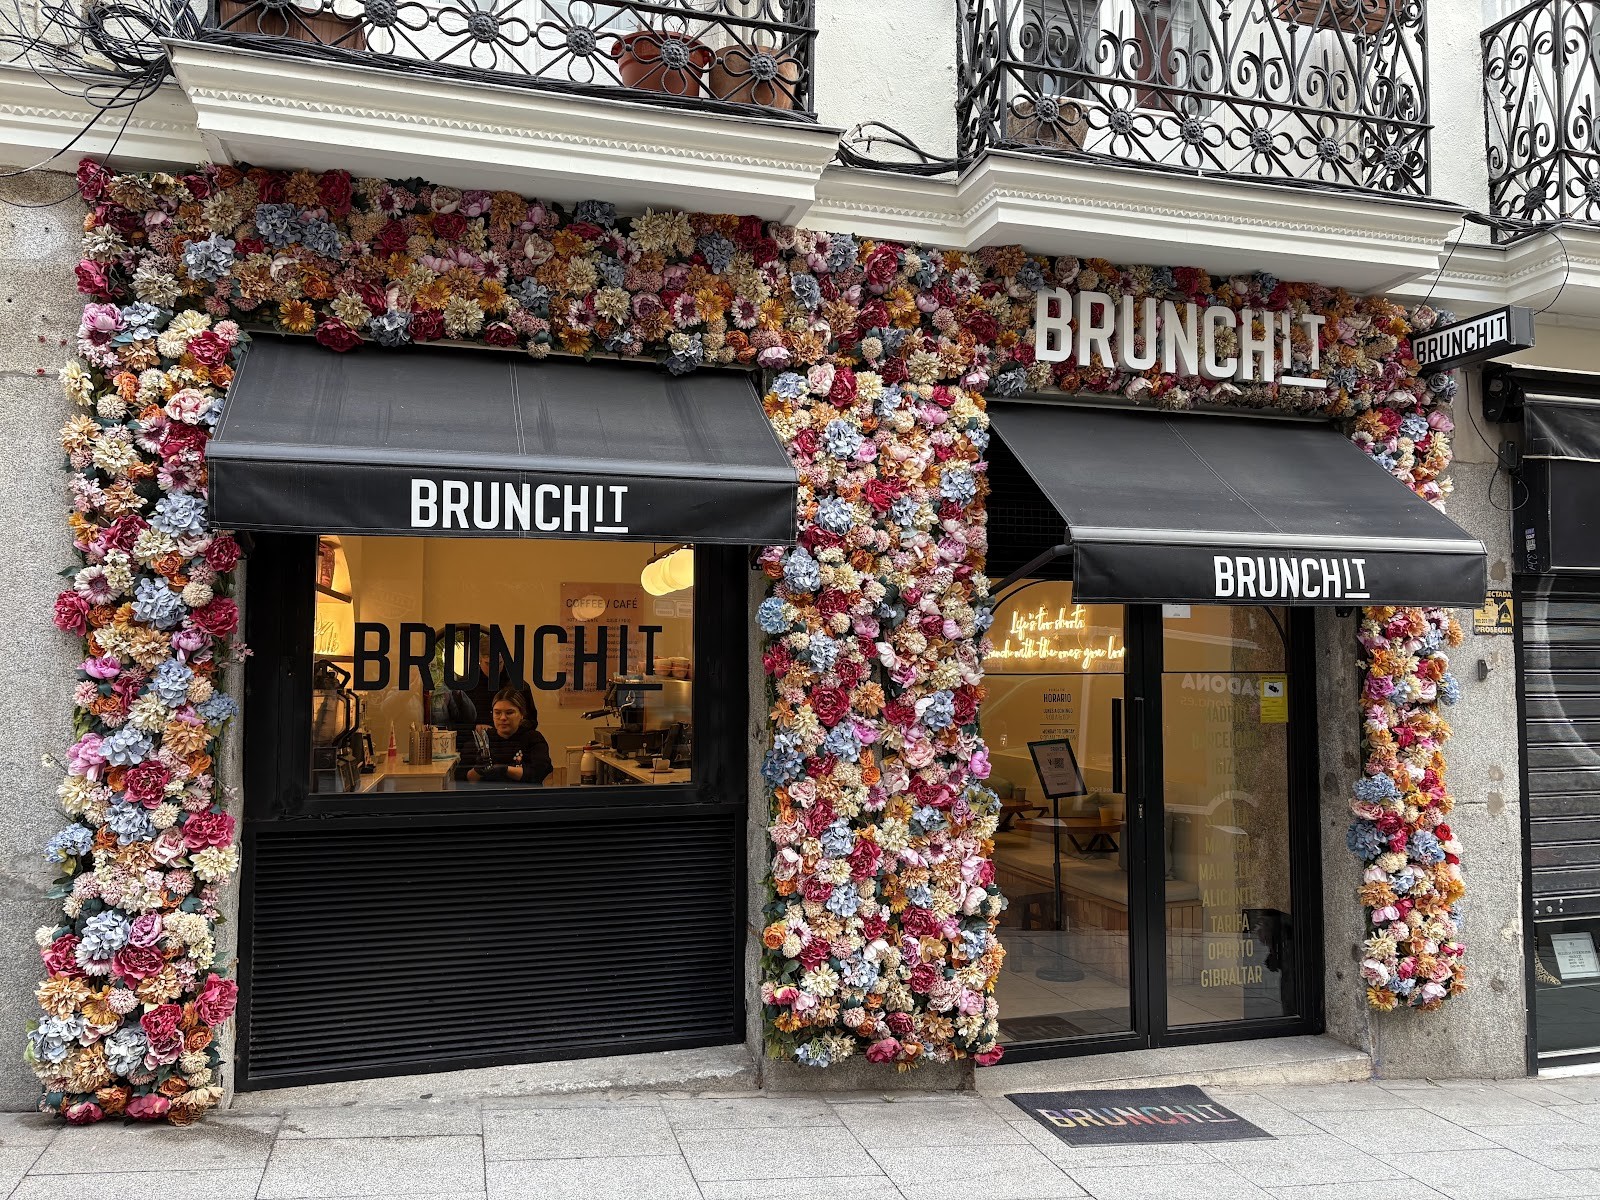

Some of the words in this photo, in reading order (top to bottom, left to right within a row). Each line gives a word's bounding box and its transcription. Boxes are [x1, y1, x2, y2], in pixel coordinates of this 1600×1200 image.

[1035, 287, 1326, 388] BRUNCHIT
[1416, 316, 1505, 365] BRUNCHIT
[411, 478, 628, 533] BRUNCHIT
[1213, 555, 1370, 598] BRUNCHIT
[566, 599, 604, 609] COFFEE
[613, 597, 638, 609] CAFÉ
[1475, 626, 1513, 634] PROSEGUR
[352, 621, 663, 691] BRUNCHIT
[983, 639, 1013, 660] runch
[1043, 693, 1072, 703] HORARIO
[1192, 729, 1260, 750] BCELONA
[1211, 756, 1245, 775] IBIZ
[1207, 782, 1247, 801] ALM
[1204, 806, 1250, 829] SILLA
[1205, 834, 1251, 855] MGA
[1199, 859, 1258, 881] MARLL
[1202, 886, 1257, 908] ALICANTE
[1210, 912, 1250, 934] TARIFA
[1208, 939, 1254, 960] OPORTO
[1200, 965, 1263, 988] GIBRALTAR
[1035, 1104, 1238, 1128] BRUNCHIT
